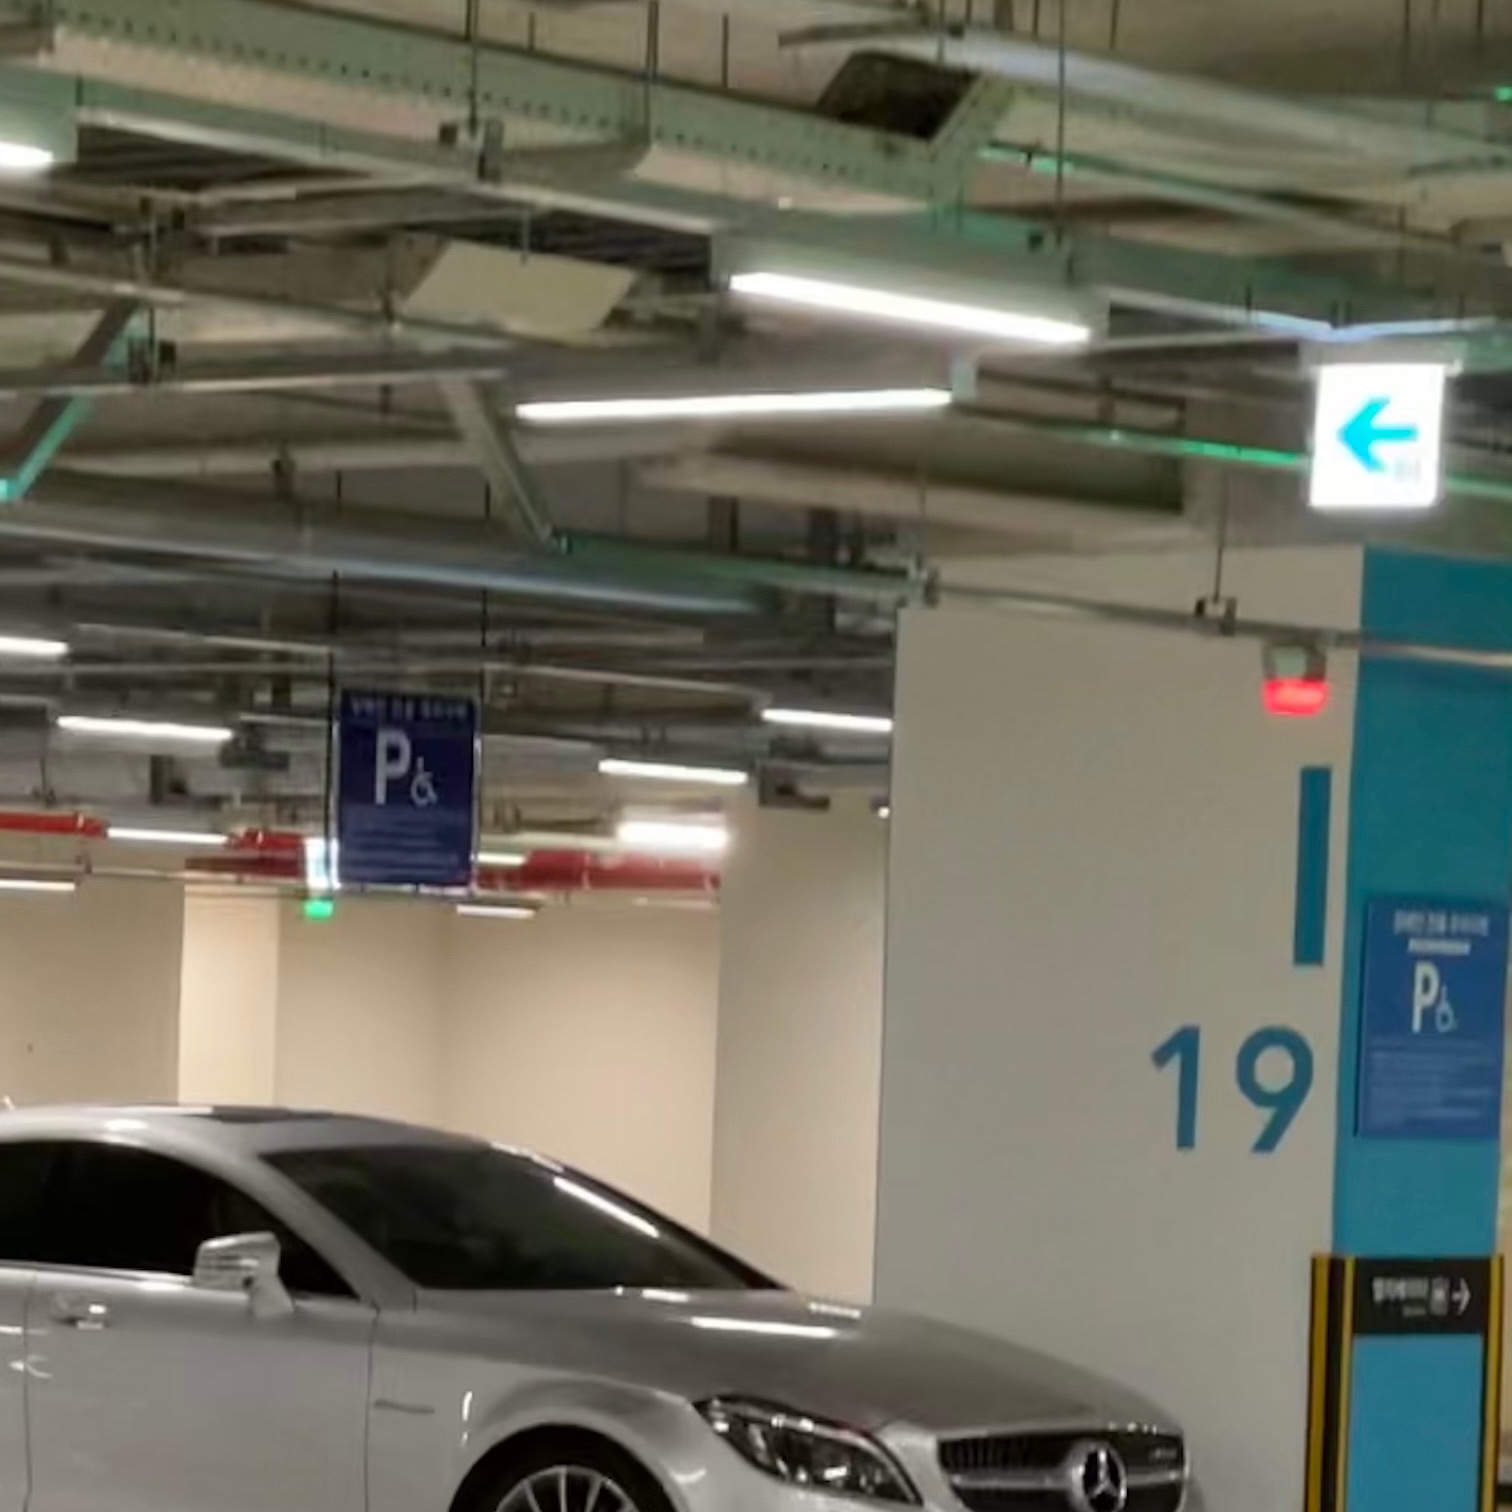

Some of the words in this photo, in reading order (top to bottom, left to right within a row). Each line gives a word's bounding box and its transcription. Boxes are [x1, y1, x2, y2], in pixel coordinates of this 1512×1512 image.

[375, 728, 412, 805] P
[1293, 766, 1332, 966] I
[1411, 960, 1440, 1034] P
[1151, 1024, 1315, 1153] 19
